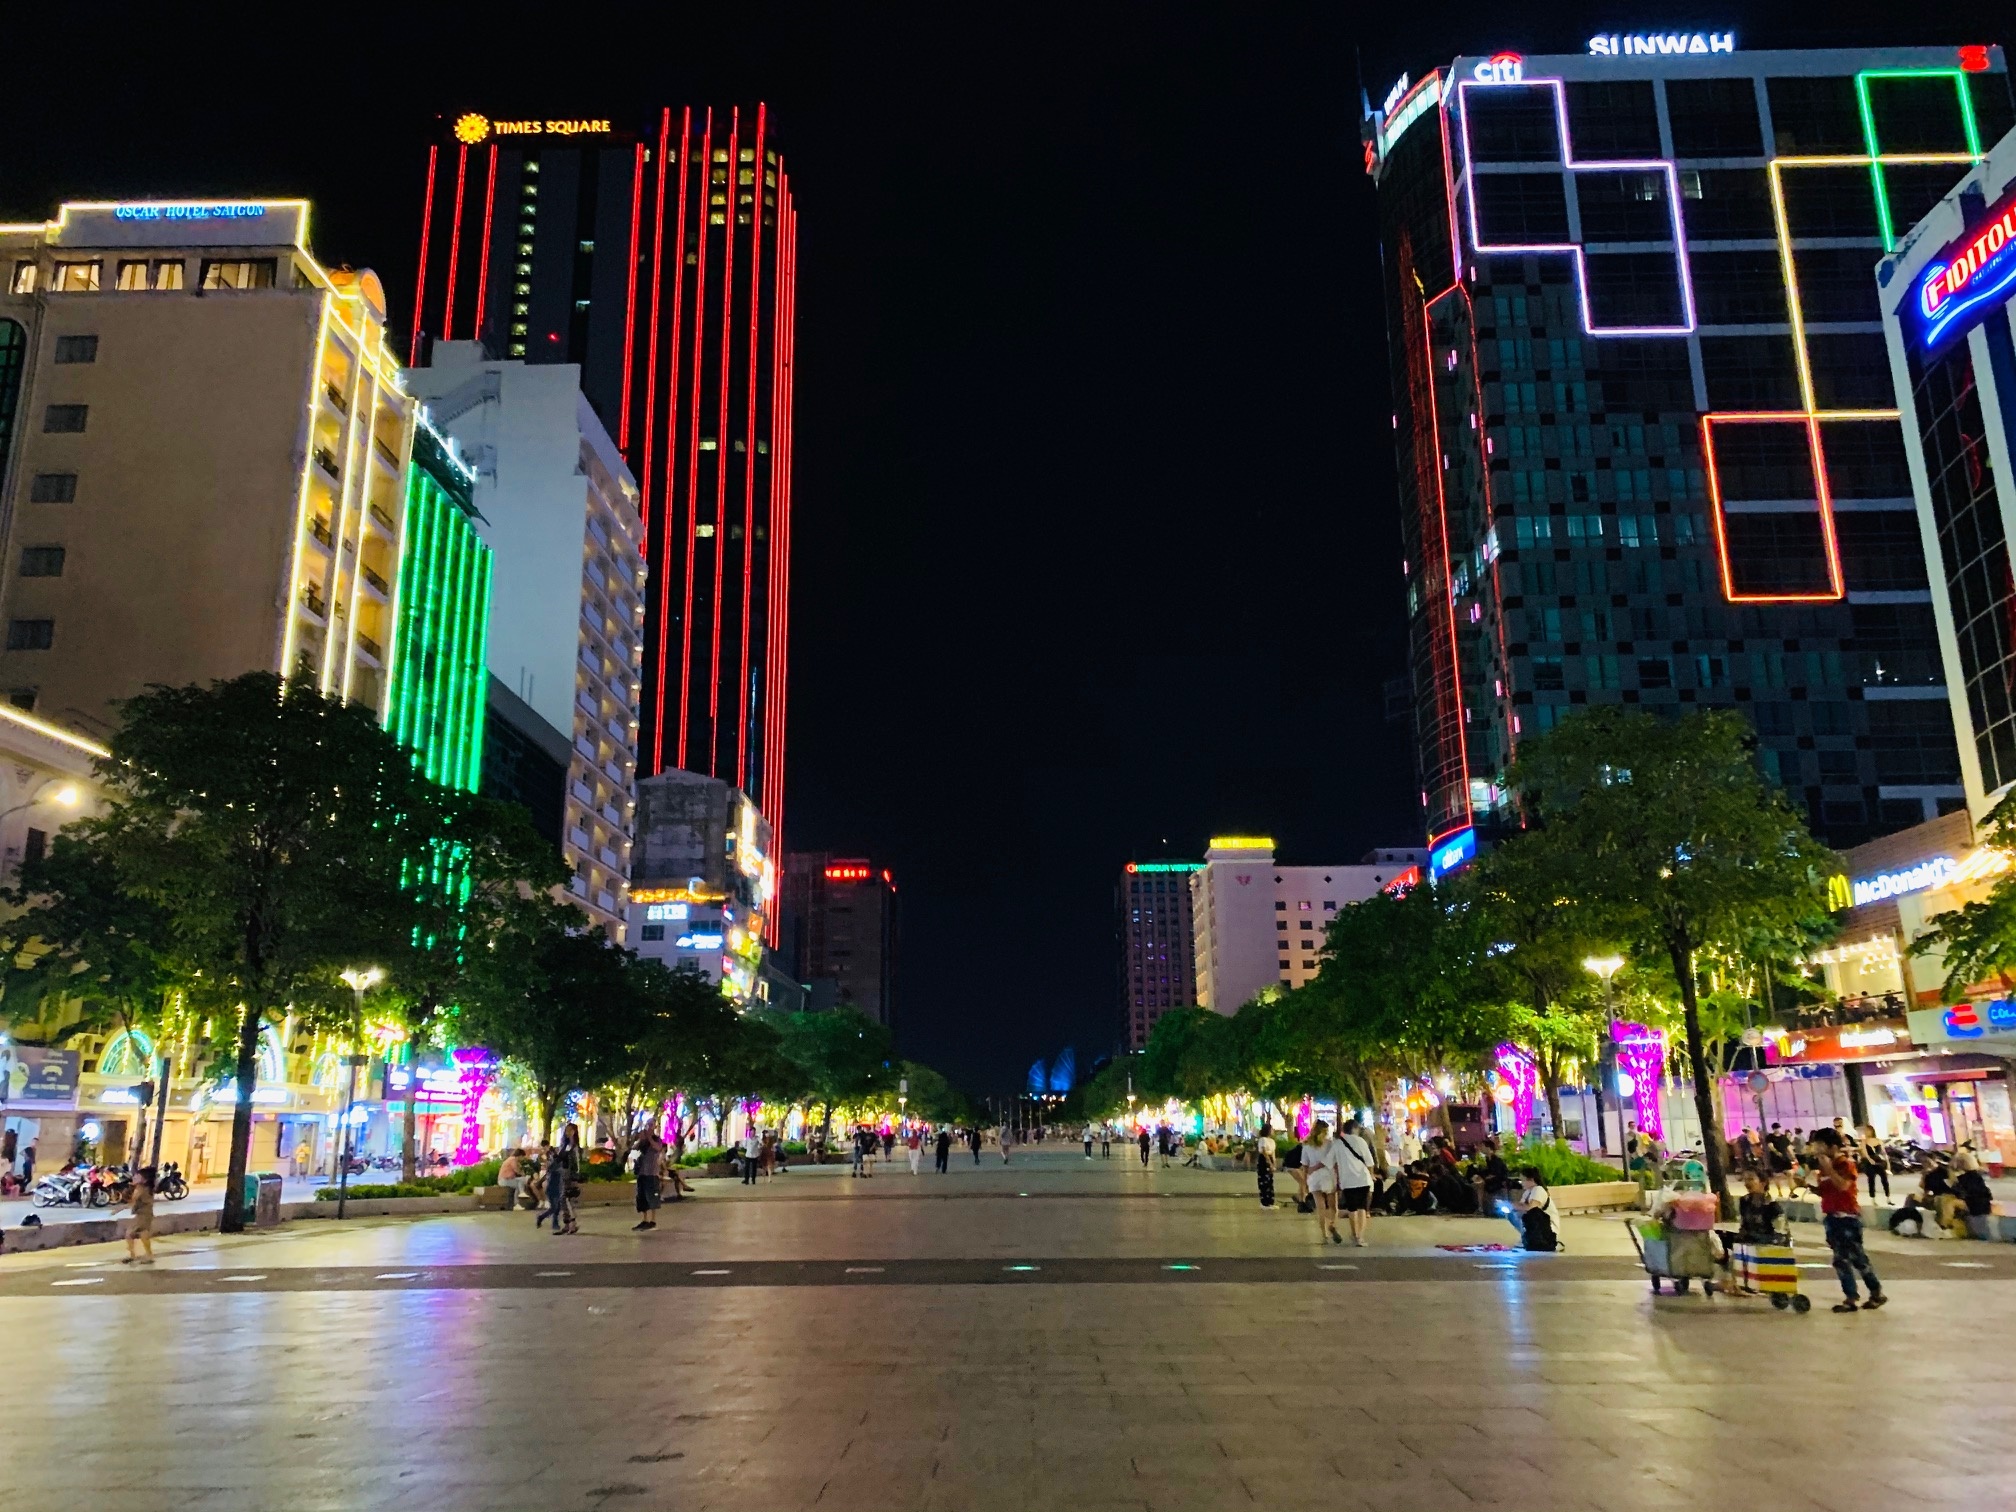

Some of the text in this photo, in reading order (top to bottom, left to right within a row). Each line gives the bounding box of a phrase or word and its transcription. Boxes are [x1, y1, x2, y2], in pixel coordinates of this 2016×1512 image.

[1588, 33, 1734, 56] SUNWAH
[494, 120, 611, 136] TIMES SQUARE
[116, 205, 265, 218] OSCAR HOTEL SAIGON
